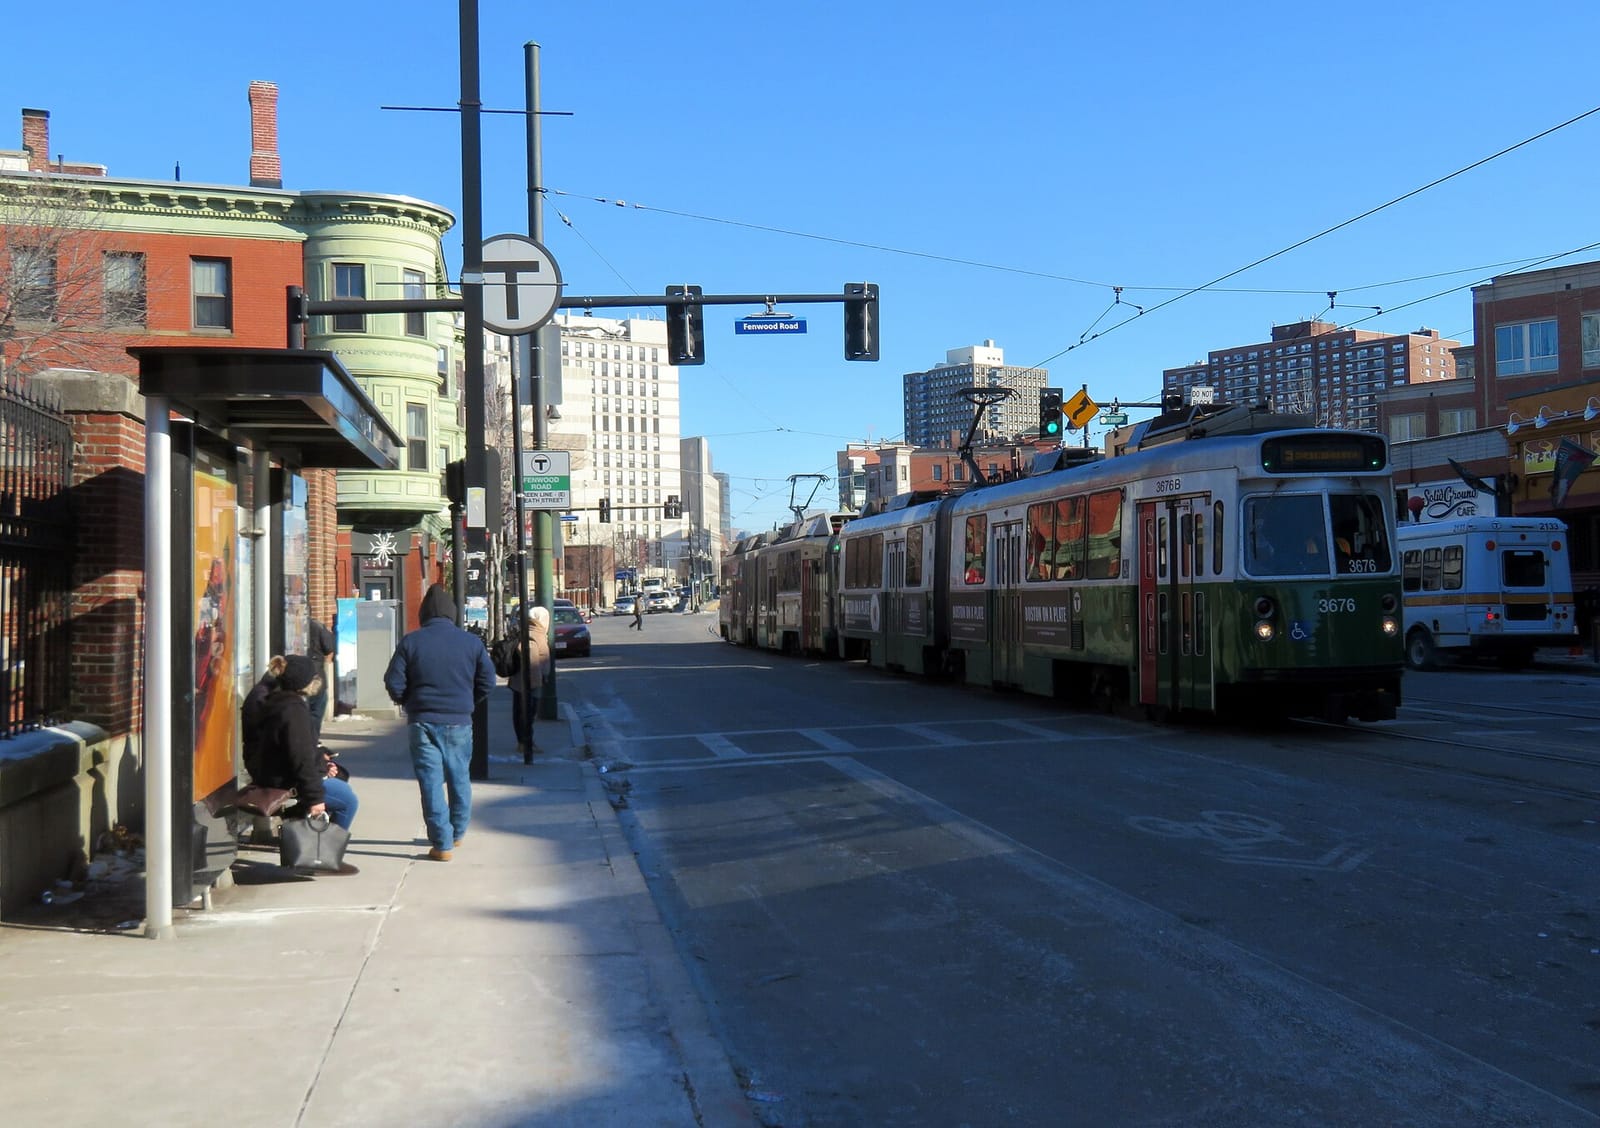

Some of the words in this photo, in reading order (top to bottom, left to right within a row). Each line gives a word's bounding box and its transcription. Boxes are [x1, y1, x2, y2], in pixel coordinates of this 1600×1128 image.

[482, 261, 540, 320] T
[743, 322, 778, 330] Fenwood
[780, 322, 799, 330] Road
[1192, 390, 1200, 398] DO
[1202, 390, 1213, 398] NOT
[534, 459, 548, 471] T
[523, 476, 560, 484] FENWOOD
[1156, 479, 1181, 492] 3676B
[1424, 488, 1444, 507] Solid
[1444, 486, 1477, 506] Ground
[1539, 522, 1559, 531] 2133
[1348, 559, 1377, 573] 3676
[1319, 598, 1356, 613] 3676
